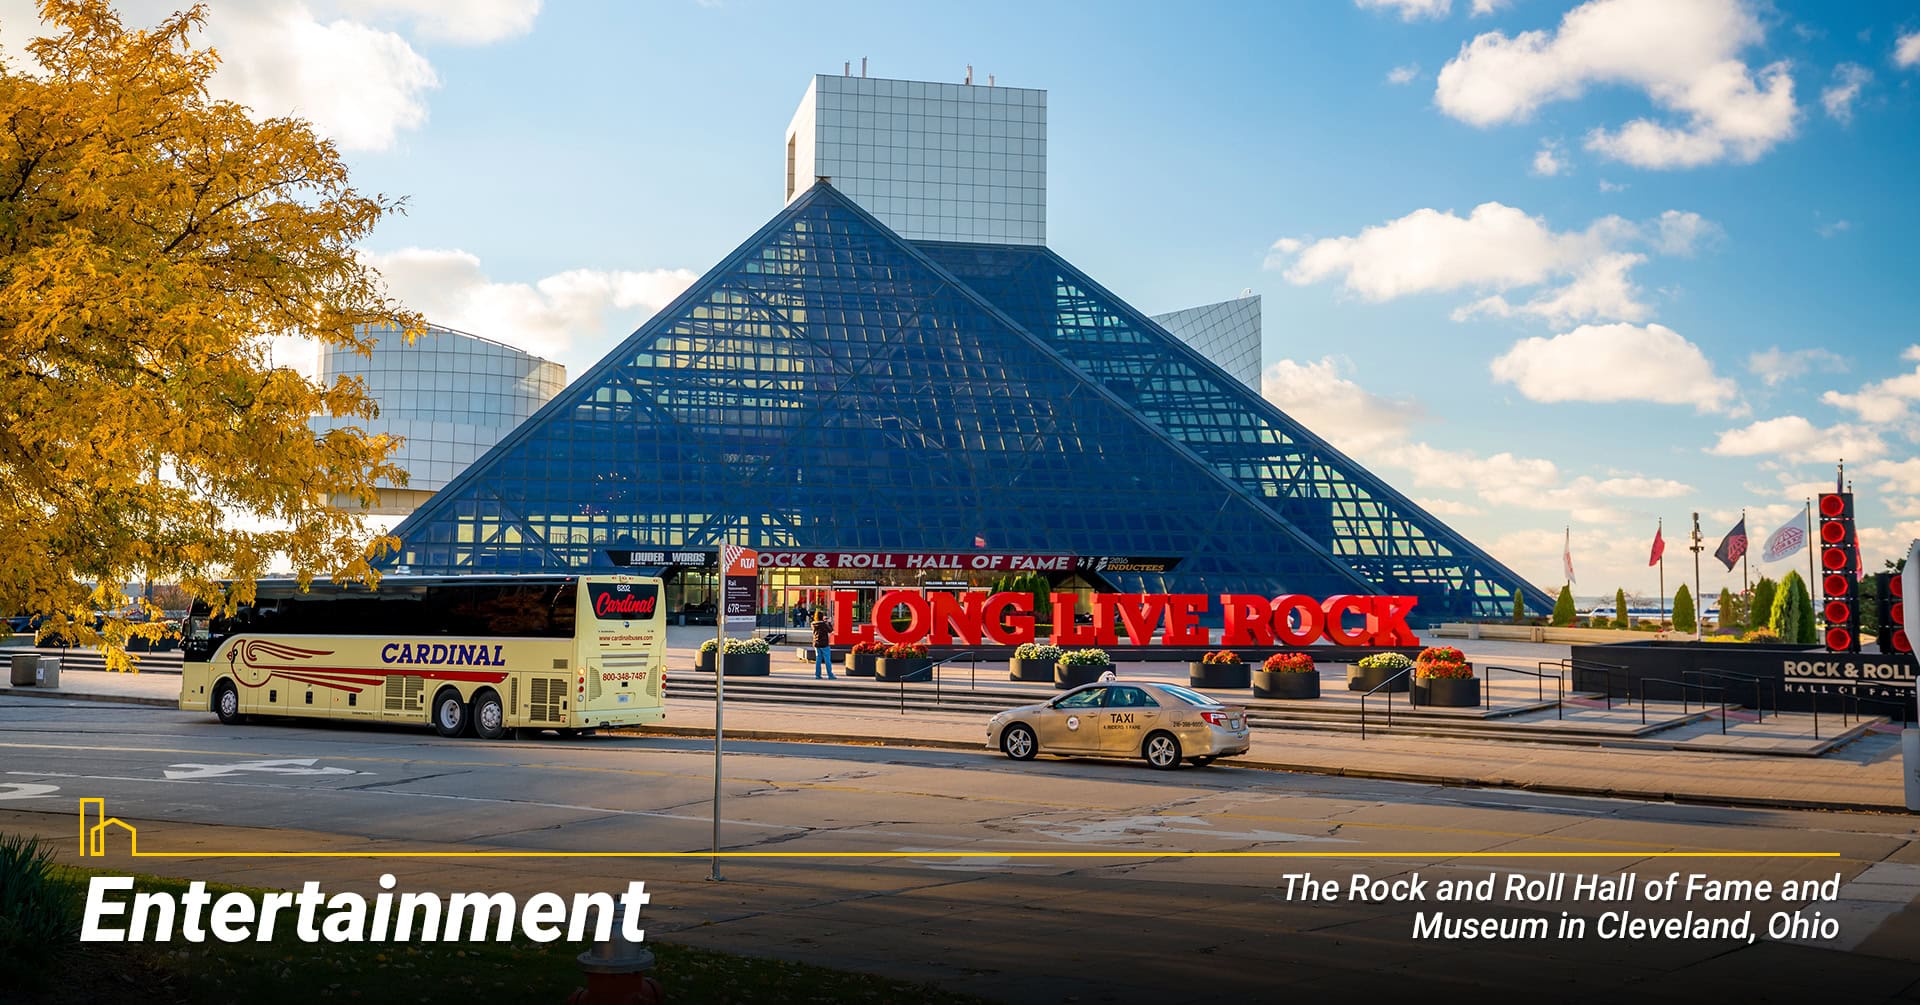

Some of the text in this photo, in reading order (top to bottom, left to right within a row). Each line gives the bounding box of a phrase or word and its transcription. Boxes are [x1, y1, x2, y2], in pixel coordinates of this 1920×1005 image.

[630, 552, 706, 562] LOUDER WORDS
[757, 553, 1070, 570] OCK & ROLL HALL OF FAME
[741, 558, 755, 569] RTA
[597, 592, 655, 616] Cardinal
[727, 603, 740, 613] 67R
[829, 591, 1420, 646] LONG LIVE ROCK
[381, 643, 506, 666] CARDINAL
[1783, 661, 1916, 680] ROCK & ROLL
[602, 672, 647, 681] 800-348-7487
[1784, 684, 1828, 694] HALL
[1110, 713, 1134, 723] TAXI
